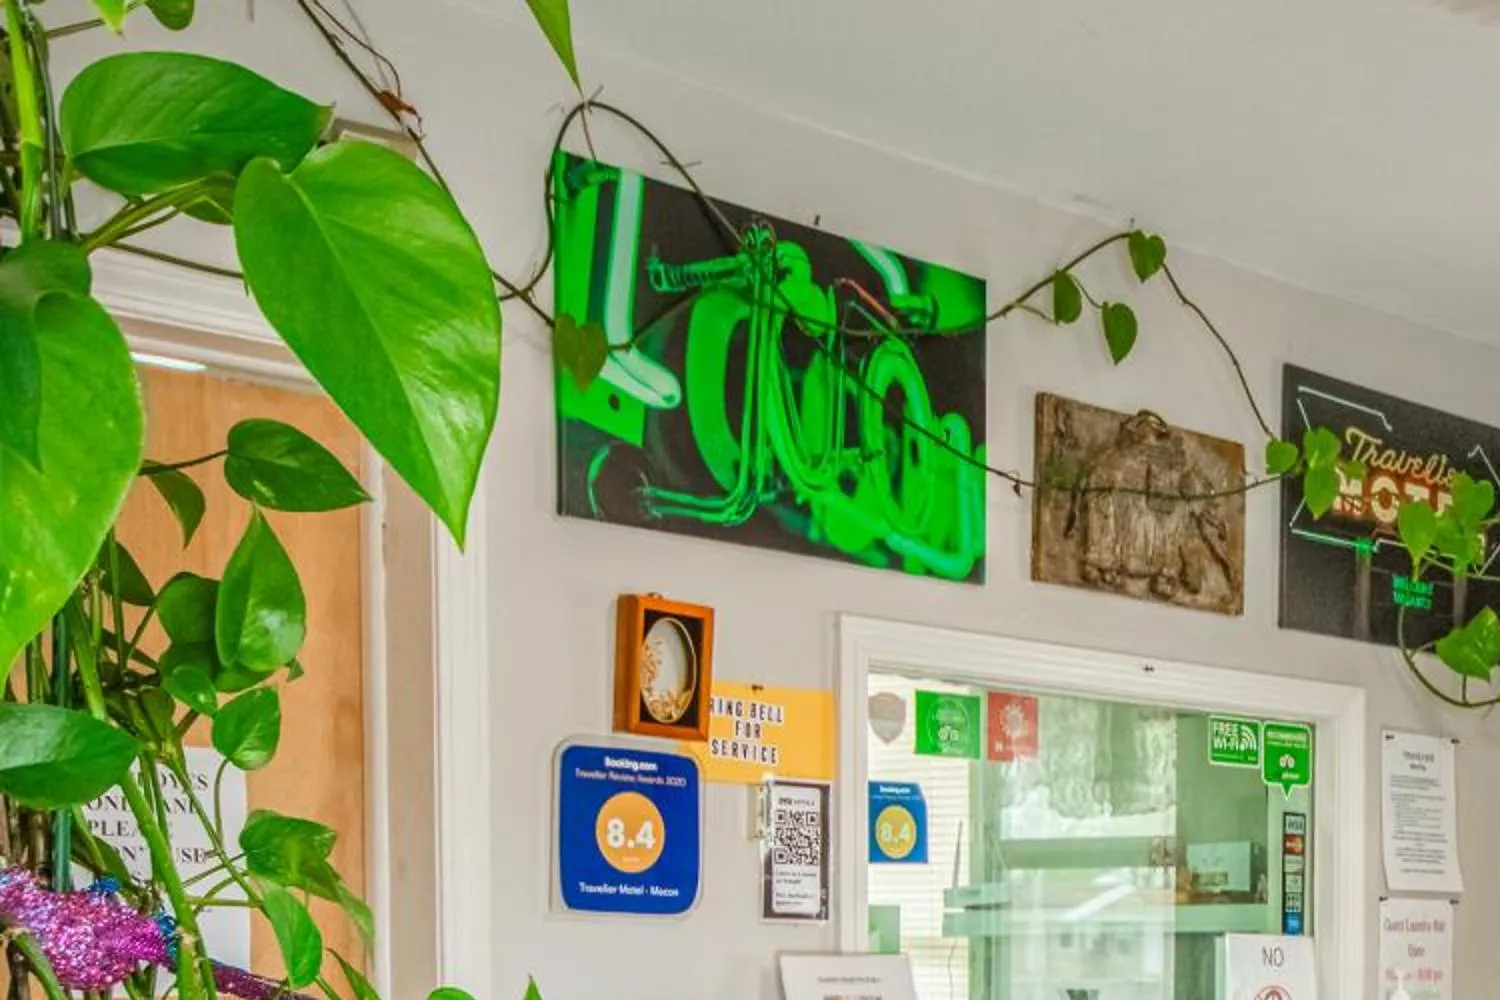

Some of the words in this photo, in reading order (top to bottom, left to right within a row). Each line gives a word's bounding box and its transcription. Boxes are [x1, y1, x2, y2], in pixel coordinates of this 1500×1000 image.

[1345, 426, 1456, 486] Travelle
[750, 702, 783, 723] BELL
[735, 720, 761, 739] FOR
[1213, 721, 1239, 736] FREE
[712, 739, 777, 764] SERVICE
[604, 756, 658, 772] Booking.com
[607, 817, 656, 849] 8.4
[880, 821, 911, 844] 8.4
[578, 881, 617, 895] Traveller
[619, 883, 645, 896] Motel
[1262, 946, 1285, 968] NO
